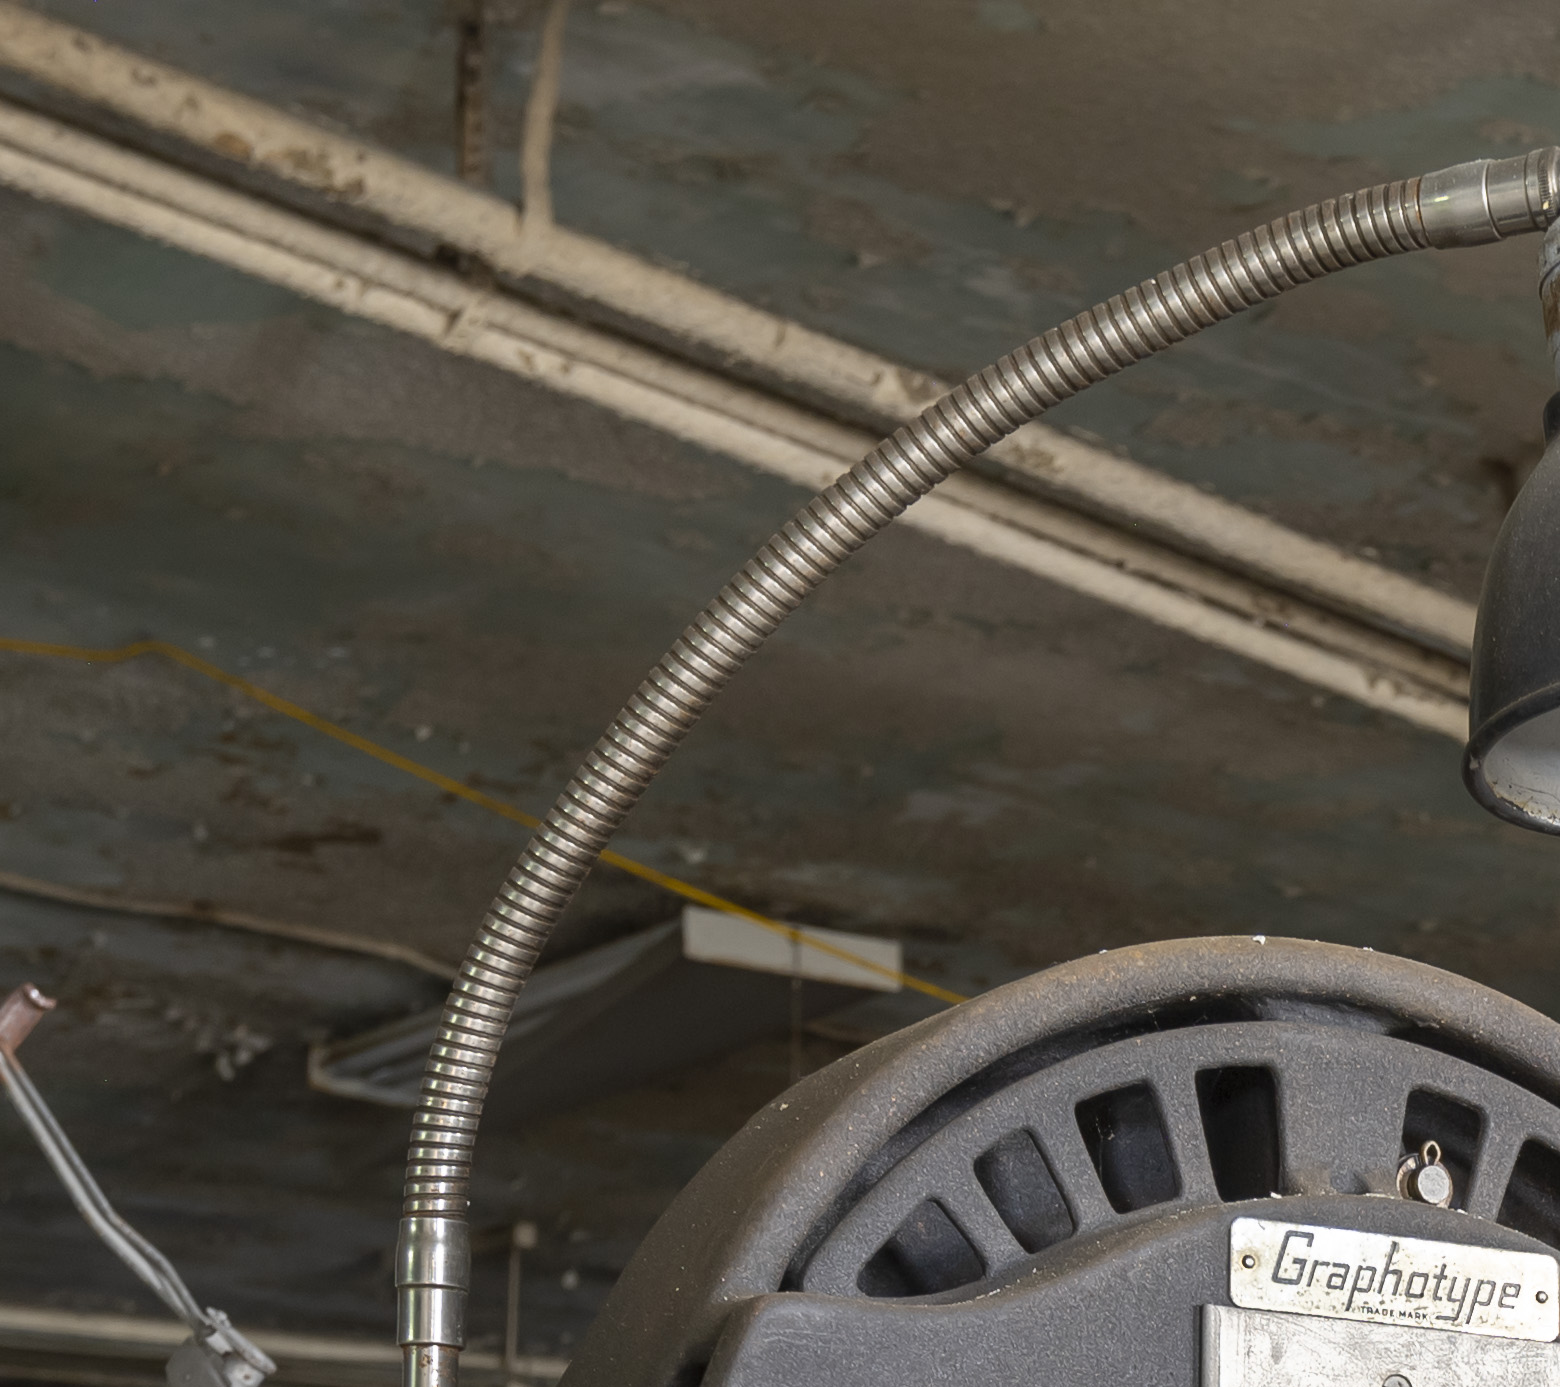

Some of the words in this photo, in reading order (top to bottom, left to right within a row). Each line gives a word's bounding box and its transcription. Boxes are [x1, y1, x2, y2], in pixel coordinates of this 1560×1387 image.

[1271, 1229, 1522, 1325] Graphotype
[1360, 1305, 1395, 1318] TRADE
[1397, 1309, 1429, 1321] MARK
